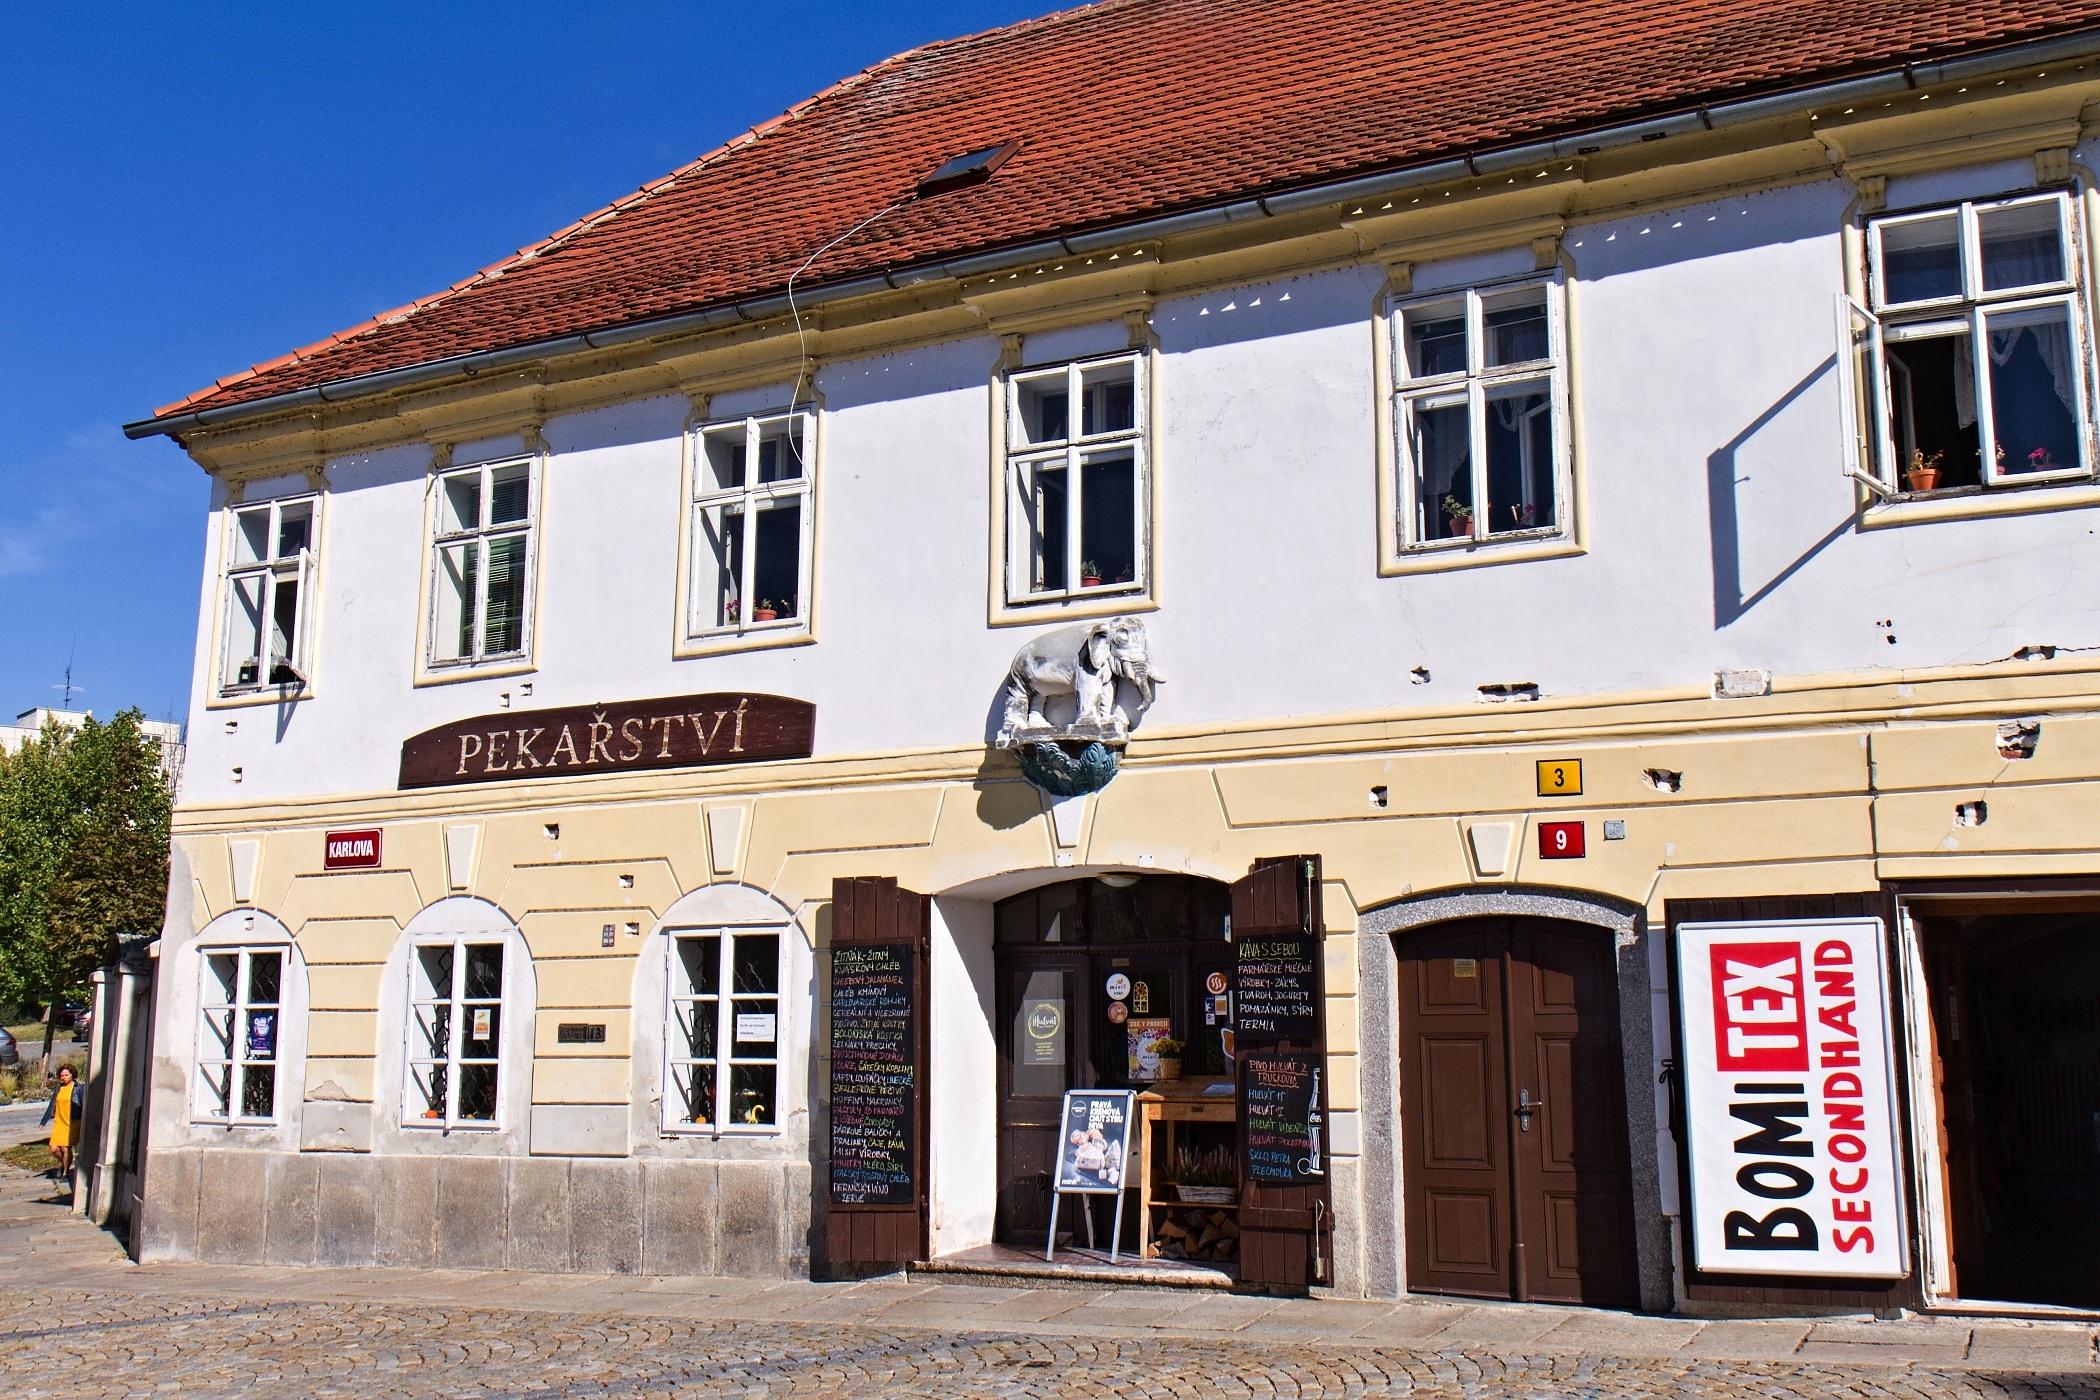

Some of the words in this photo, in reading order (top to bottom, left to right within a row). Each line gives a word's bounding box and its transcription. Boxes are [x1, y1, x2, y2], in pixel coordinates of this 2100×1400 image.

[455, 698, 748, 774] PEKAŘSTVÍ
[1554, 768, 1564, 787] 3
[1556, 830, 1567, 850] 9
[329, 840, 374, 858] KARLOVA
[1240, 938, 1260, 958] KÁVA
[1262, 943, 1269, 956] S
[1270, 942, 1300, 956] SEBOU
[876, 958, 900, 971] CHLÉB
[834, 986, 855, 998] CHLÉB
[1274, 991, 1309, 1001] JOGURTY
[1292, 1001, 1313, 1017] SÝRY
[1249, 1059, 1268, 1070] PIVO
